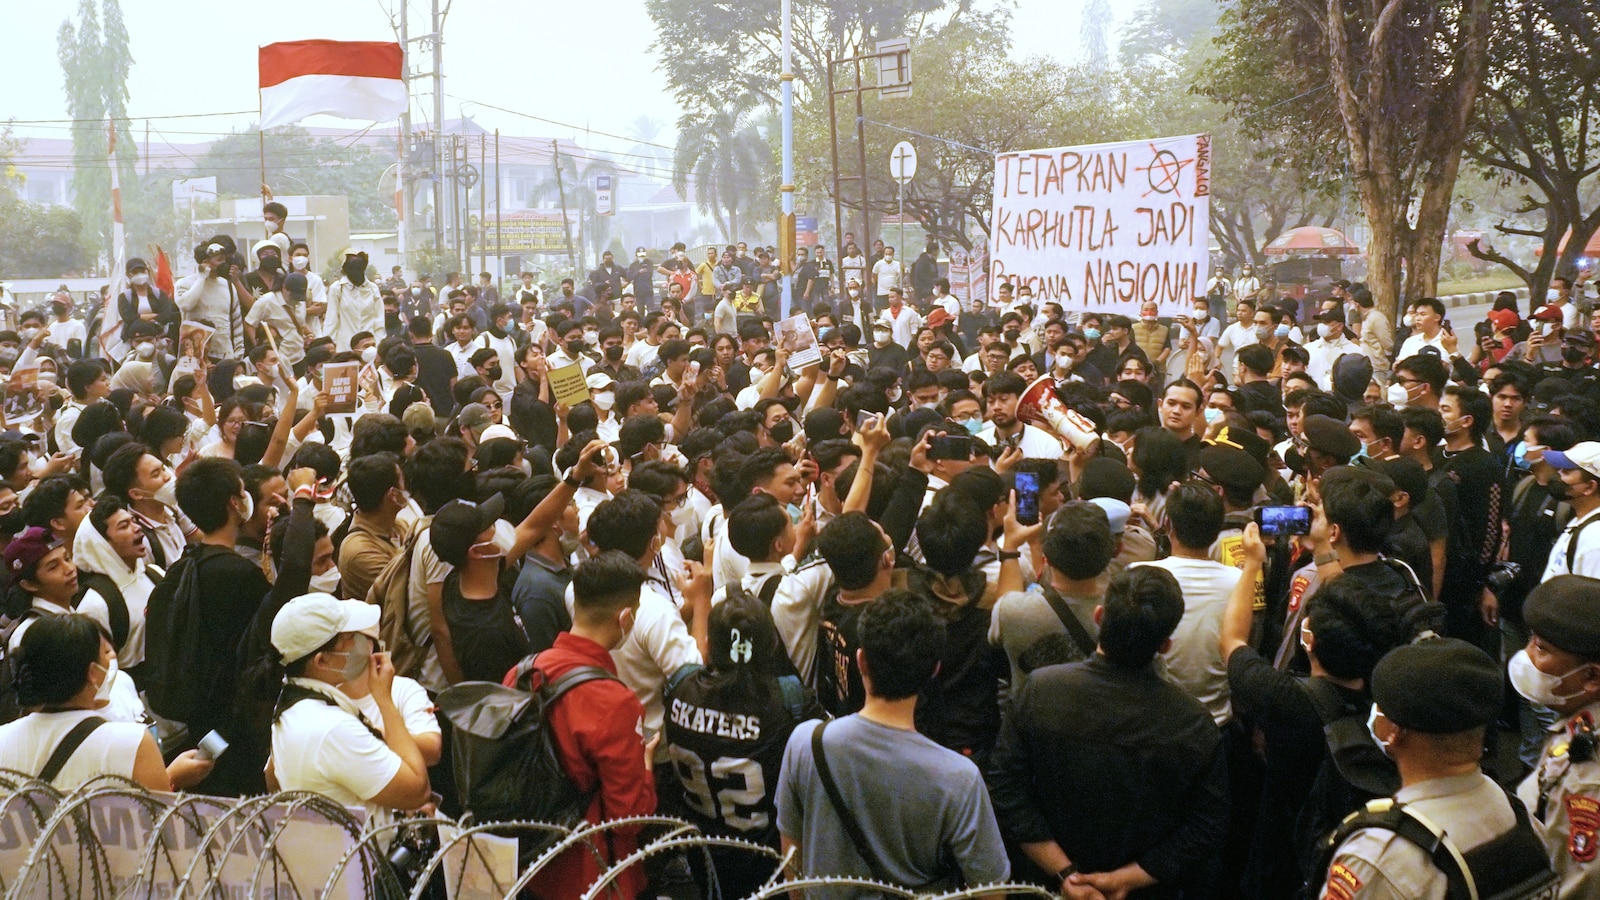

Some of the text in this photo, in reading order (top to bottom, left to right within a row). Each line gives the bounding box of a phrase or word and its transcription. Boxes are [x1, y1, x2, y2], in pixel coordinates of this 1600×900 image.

[997, 151, 1127, 198] TETAPKAN
[996, 201, 1194, 252] KARHUTLA JADI
[1084, 258, 1198, 307] NASIONAL
[670, 697, 761, 741] SKATERS
